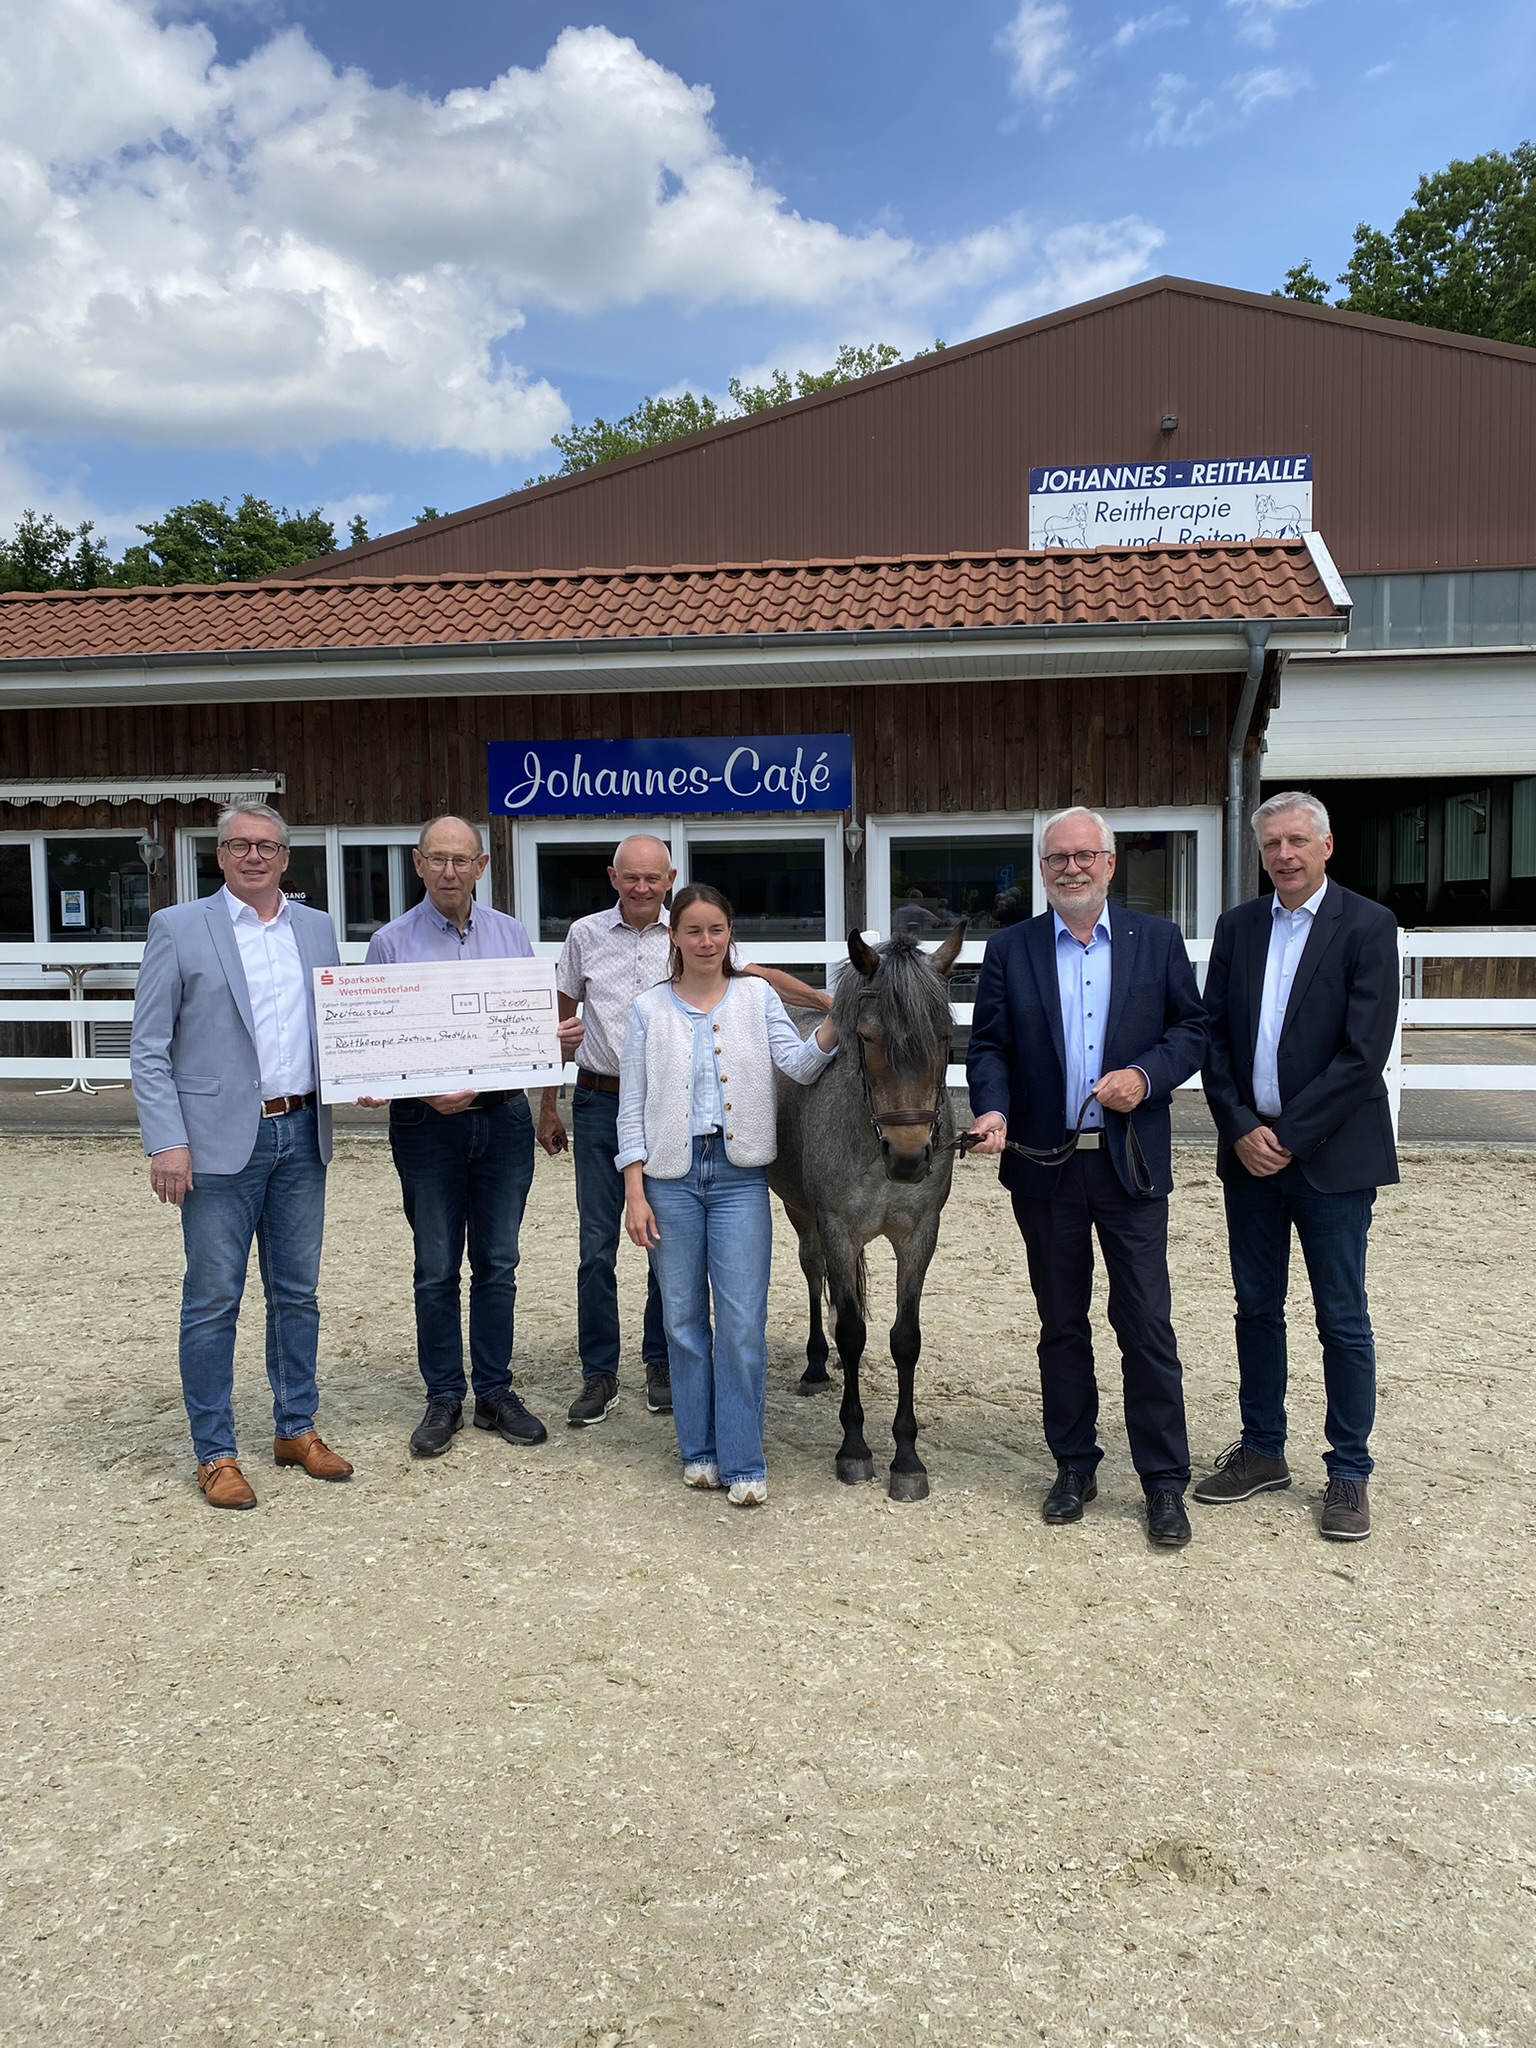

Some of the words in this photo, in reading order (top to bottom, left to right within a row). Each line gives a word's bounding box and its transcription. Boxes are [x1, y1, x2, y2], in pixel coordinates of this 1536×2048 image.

[1037, 465, 1168, 493] JOHANNES
[1190, 458, 1307, 485] REITHALLE
[1095, 496, 1232, 526] Reittherapie
[503, 746, 831, 809] Johannes-Café
[338, 975, 386, 986] Sparkasse
[339, 984, 420, 996] Westmünsterland
[325, 1005, 395, 1021] Dreitausend
